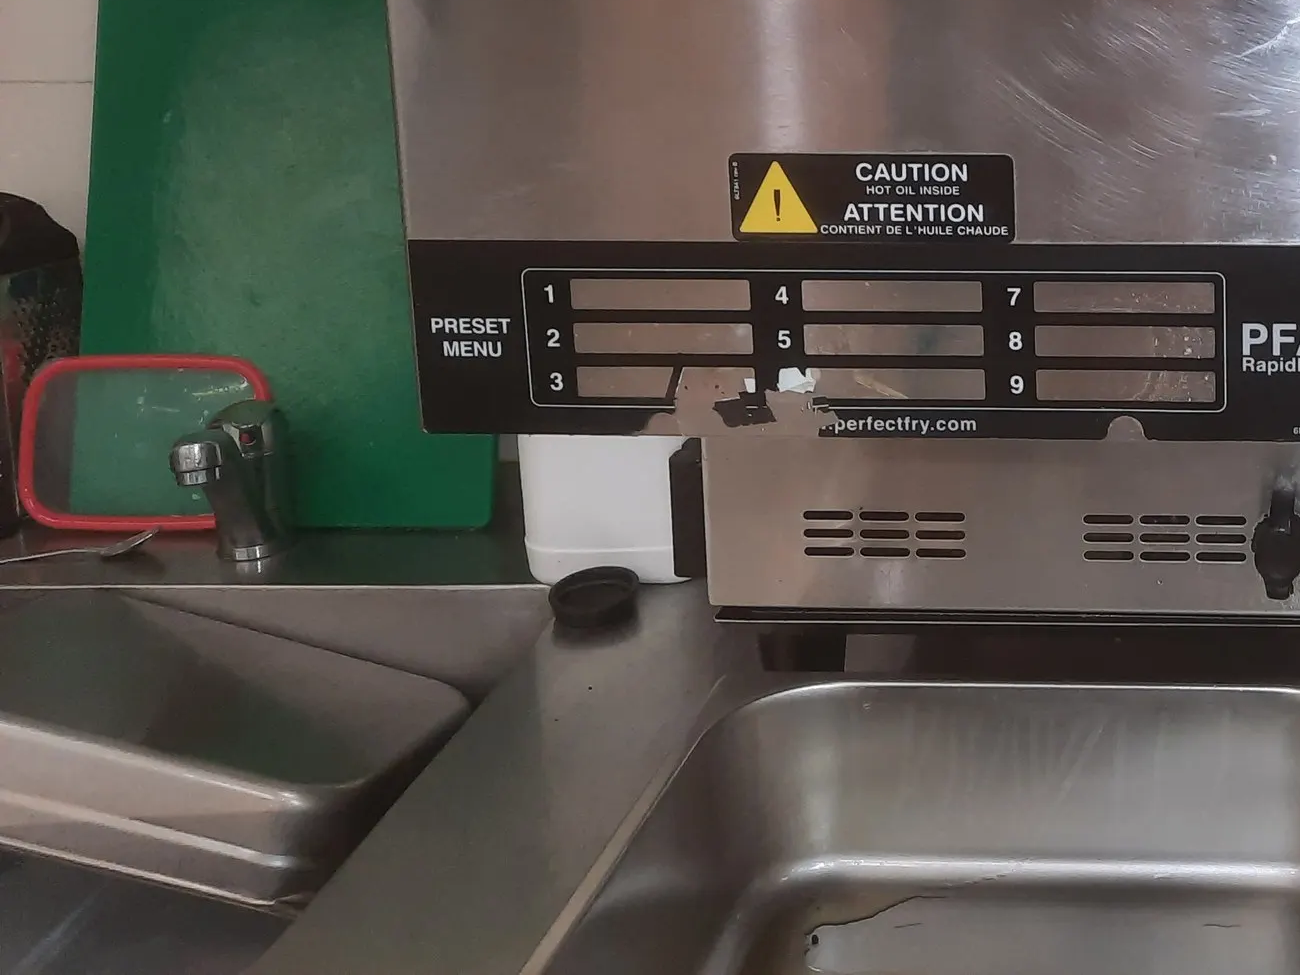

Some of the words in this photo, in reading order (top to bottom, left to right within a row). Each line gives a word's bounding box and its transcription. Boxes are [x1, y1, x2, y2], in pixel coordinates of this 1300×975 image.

[855, 162, 968, 183] CAUTION
[866, 185, 892, 196] HOT
[895, 185, 916, 196] OIL
[919, 186, 960, 196] INSIDE
[843, 203, 984, 223] ATTENTION
[820, 224, 881, 235] CONTIENT
[886, 225, 902, 235] DE
[905, 225, 953, 235] L'HUILE
[957, 225, 1009, 236] CHAUDE
[544, 284, 554, 303] 1
[775, 286, 789, 305] 4
[1006, 287, 1021, 306] 7
[430, 318, 511, 334] PRESET
[547, 329, 560, 347] 2
[777, 330, 792, 349] 5
[1008, 332, 1024, 351] 8
[443, 341, 502, 357] MENU
[550, 373, 564, 391] 3
[1010, 376, 1024, 395] 9
[822, 415, 977, 436] .perfectfry.com
